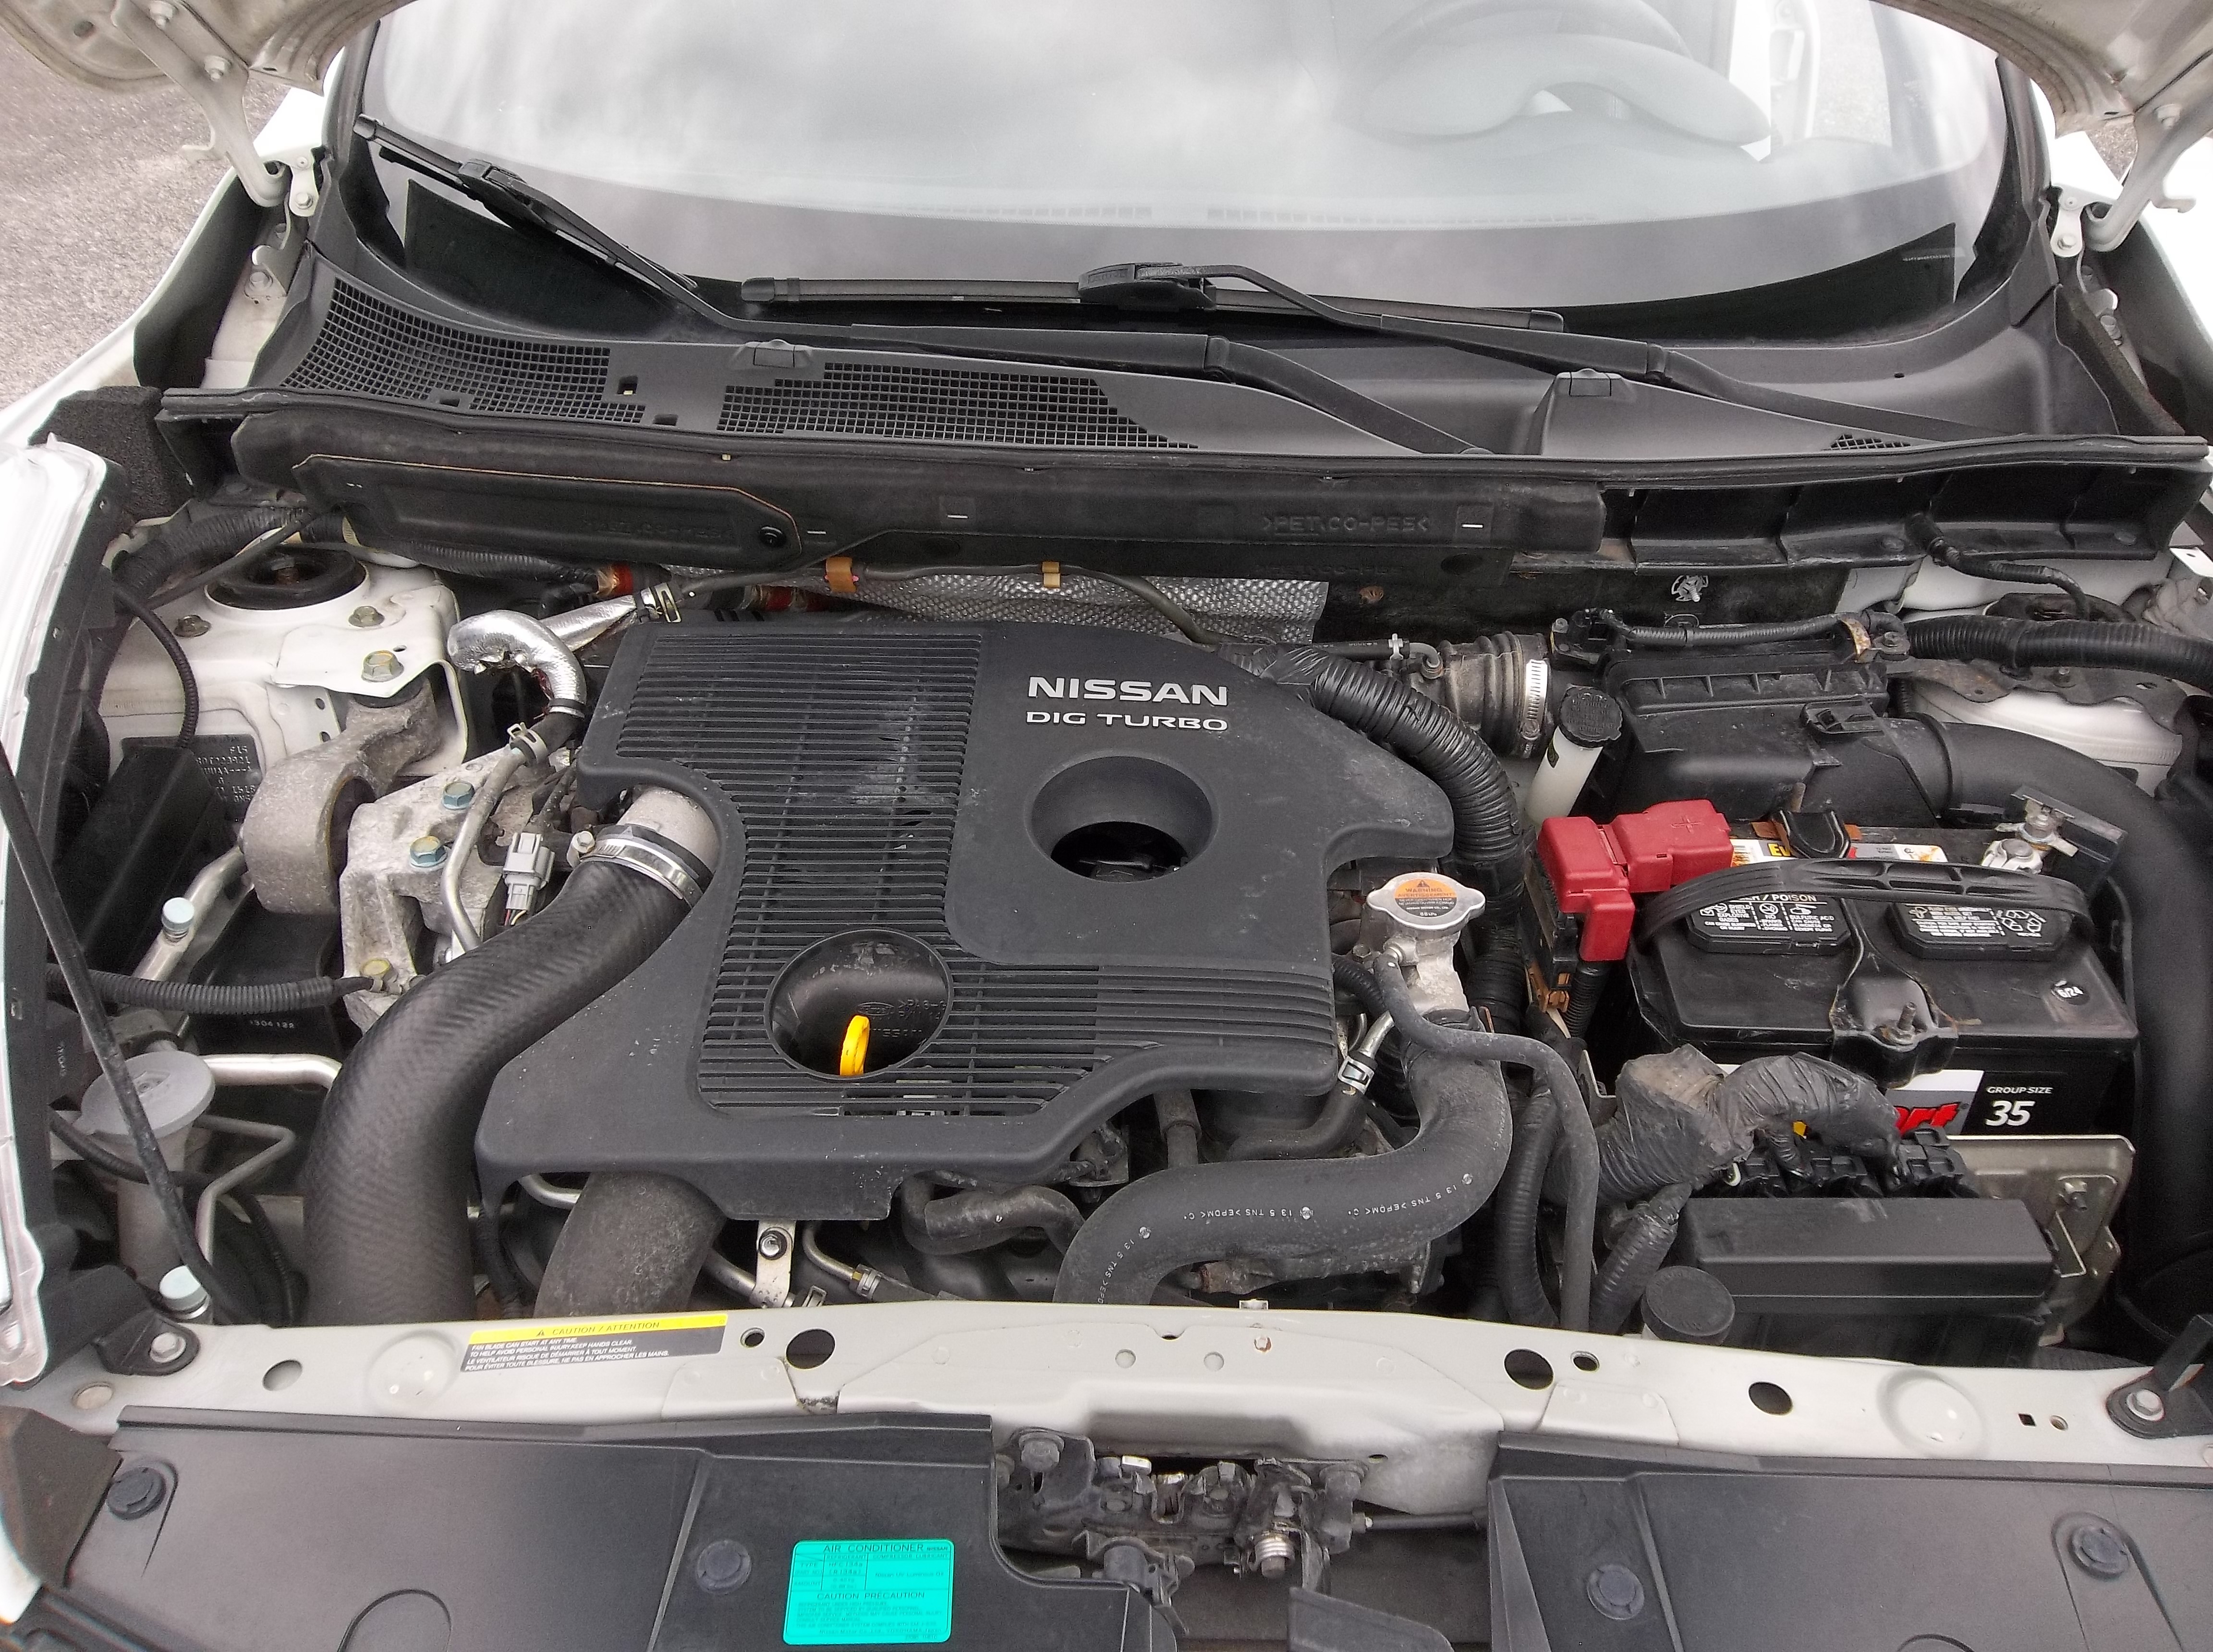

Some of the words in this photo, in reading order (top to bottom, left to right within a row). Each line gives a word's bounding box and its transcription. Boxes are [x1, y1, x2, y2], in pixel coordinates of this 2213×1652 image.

[1028, 677, 1228, 706] NISSAN
[1026, 712, 1086, 725] DIG
[1096, 714, 1228, 731] TURBO
[2057, 986, 2084, 998] 6/24
[1984, 1101, 2036, 1126] 35
[1410, 1196, 1431, 1207] TNS
[1245, 1208, 1265, 1217] TNS
[552, 1326, 596, 1336] CAUTION
[606, 1322, 660, 1331] ATTENTION
[594, 1353, 634, 1361] APPROCHER
[823, 1544, 841, 1553] AIR
[848, 1543, 924, 1553] CONDITIONER
